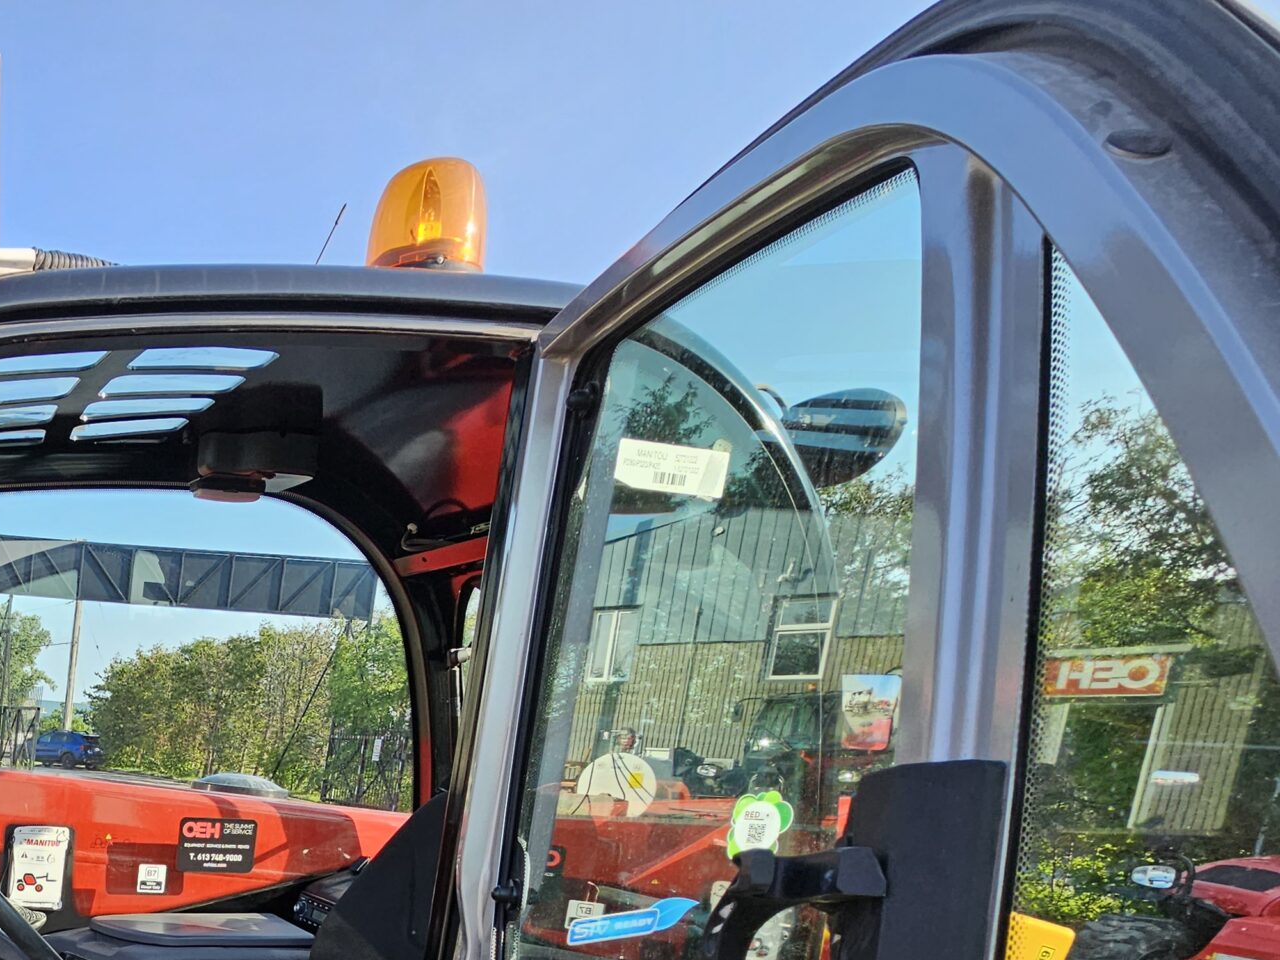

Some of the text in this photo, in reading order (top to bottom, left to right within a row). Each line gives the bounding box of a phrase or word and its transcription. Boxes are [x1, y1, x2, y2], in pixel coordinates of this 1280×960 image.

[182, 821, 221, 839] OEH
[26, 839, 61, 847] MANITOU
[189, 852, 197, 860] T.
[197, 853, 210, 861] 613
